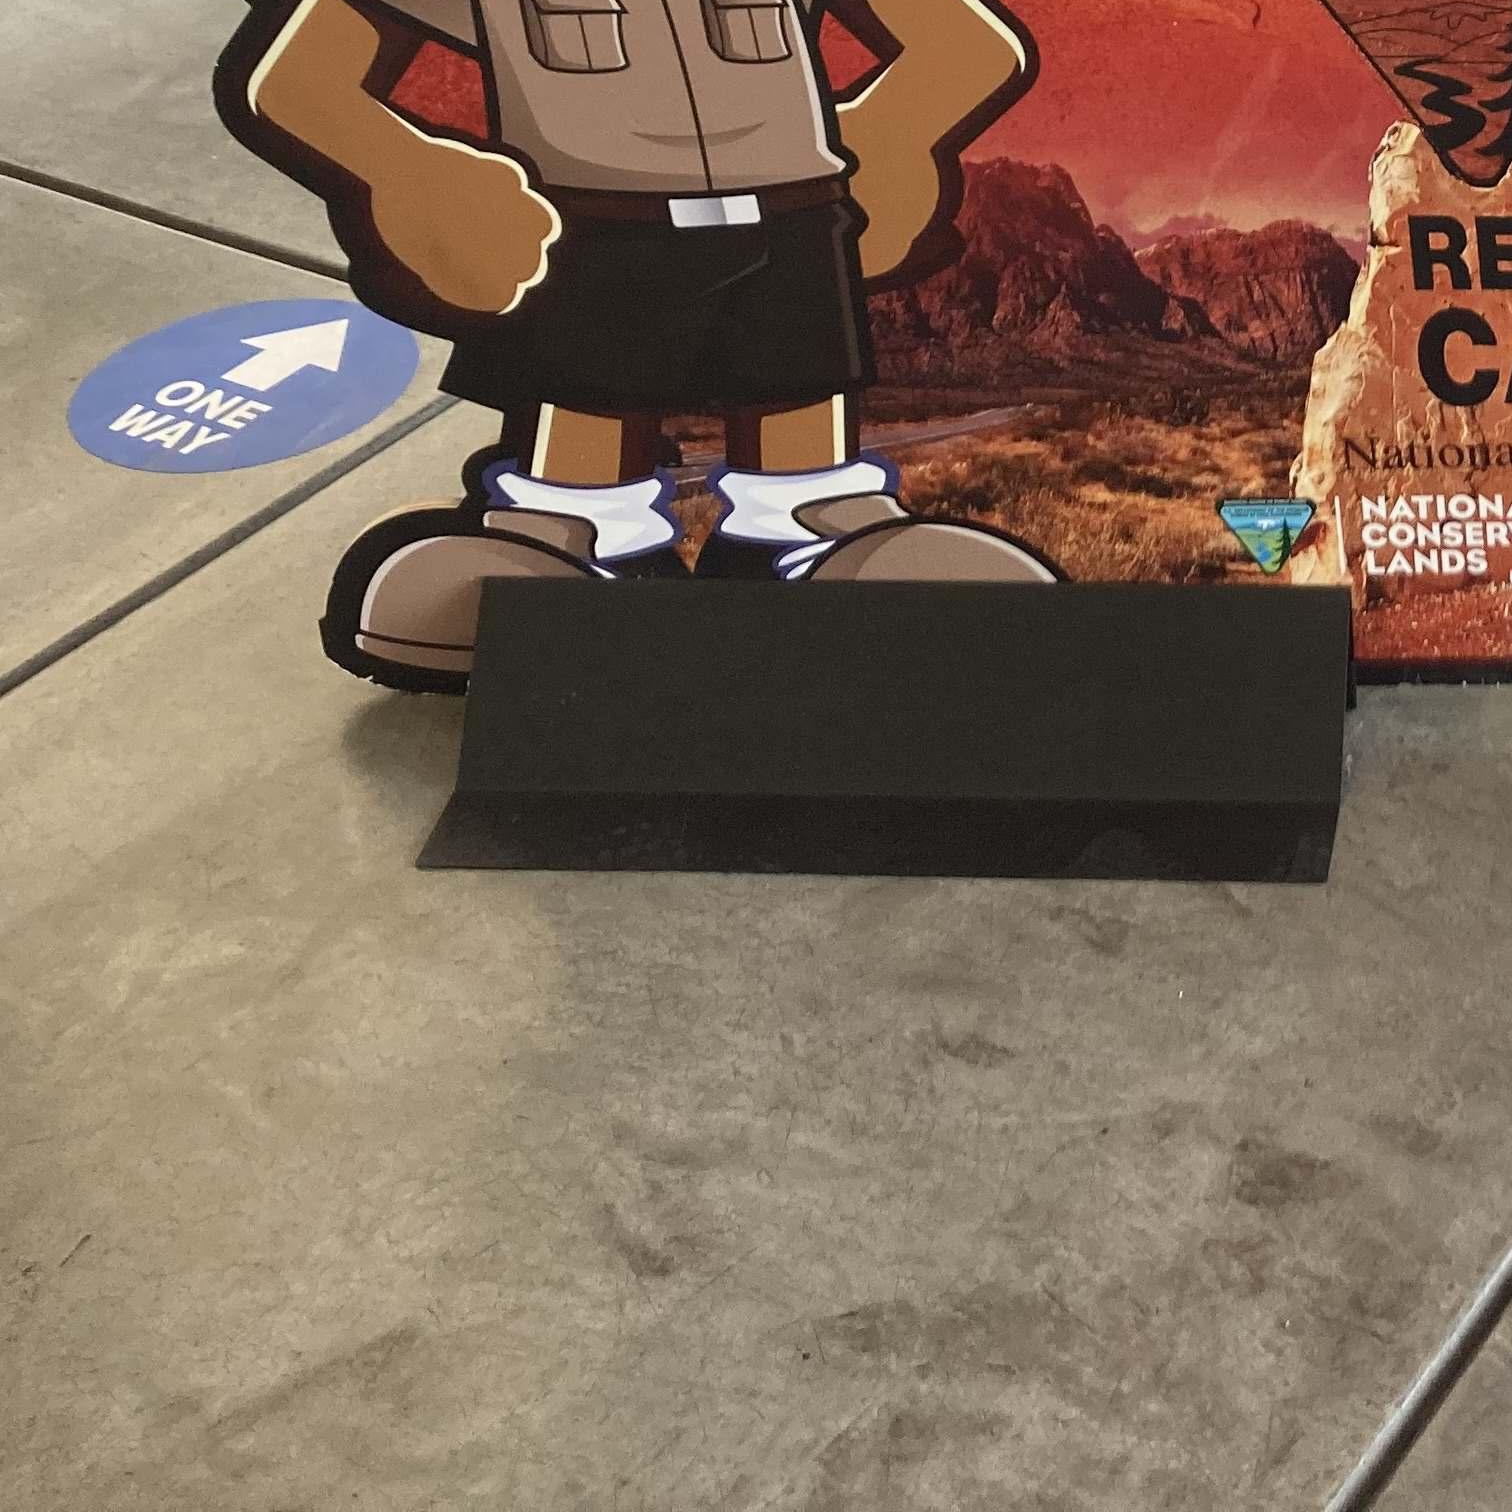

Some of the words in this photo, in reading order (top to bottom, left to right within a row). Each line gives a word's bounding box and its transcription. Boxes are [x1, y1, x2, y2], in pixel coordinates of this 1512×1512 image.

[108, 403, 233, 455] WAY
[154, 380, 274, 431] ONE
[1365, 548, 1488, 576] LANDS
